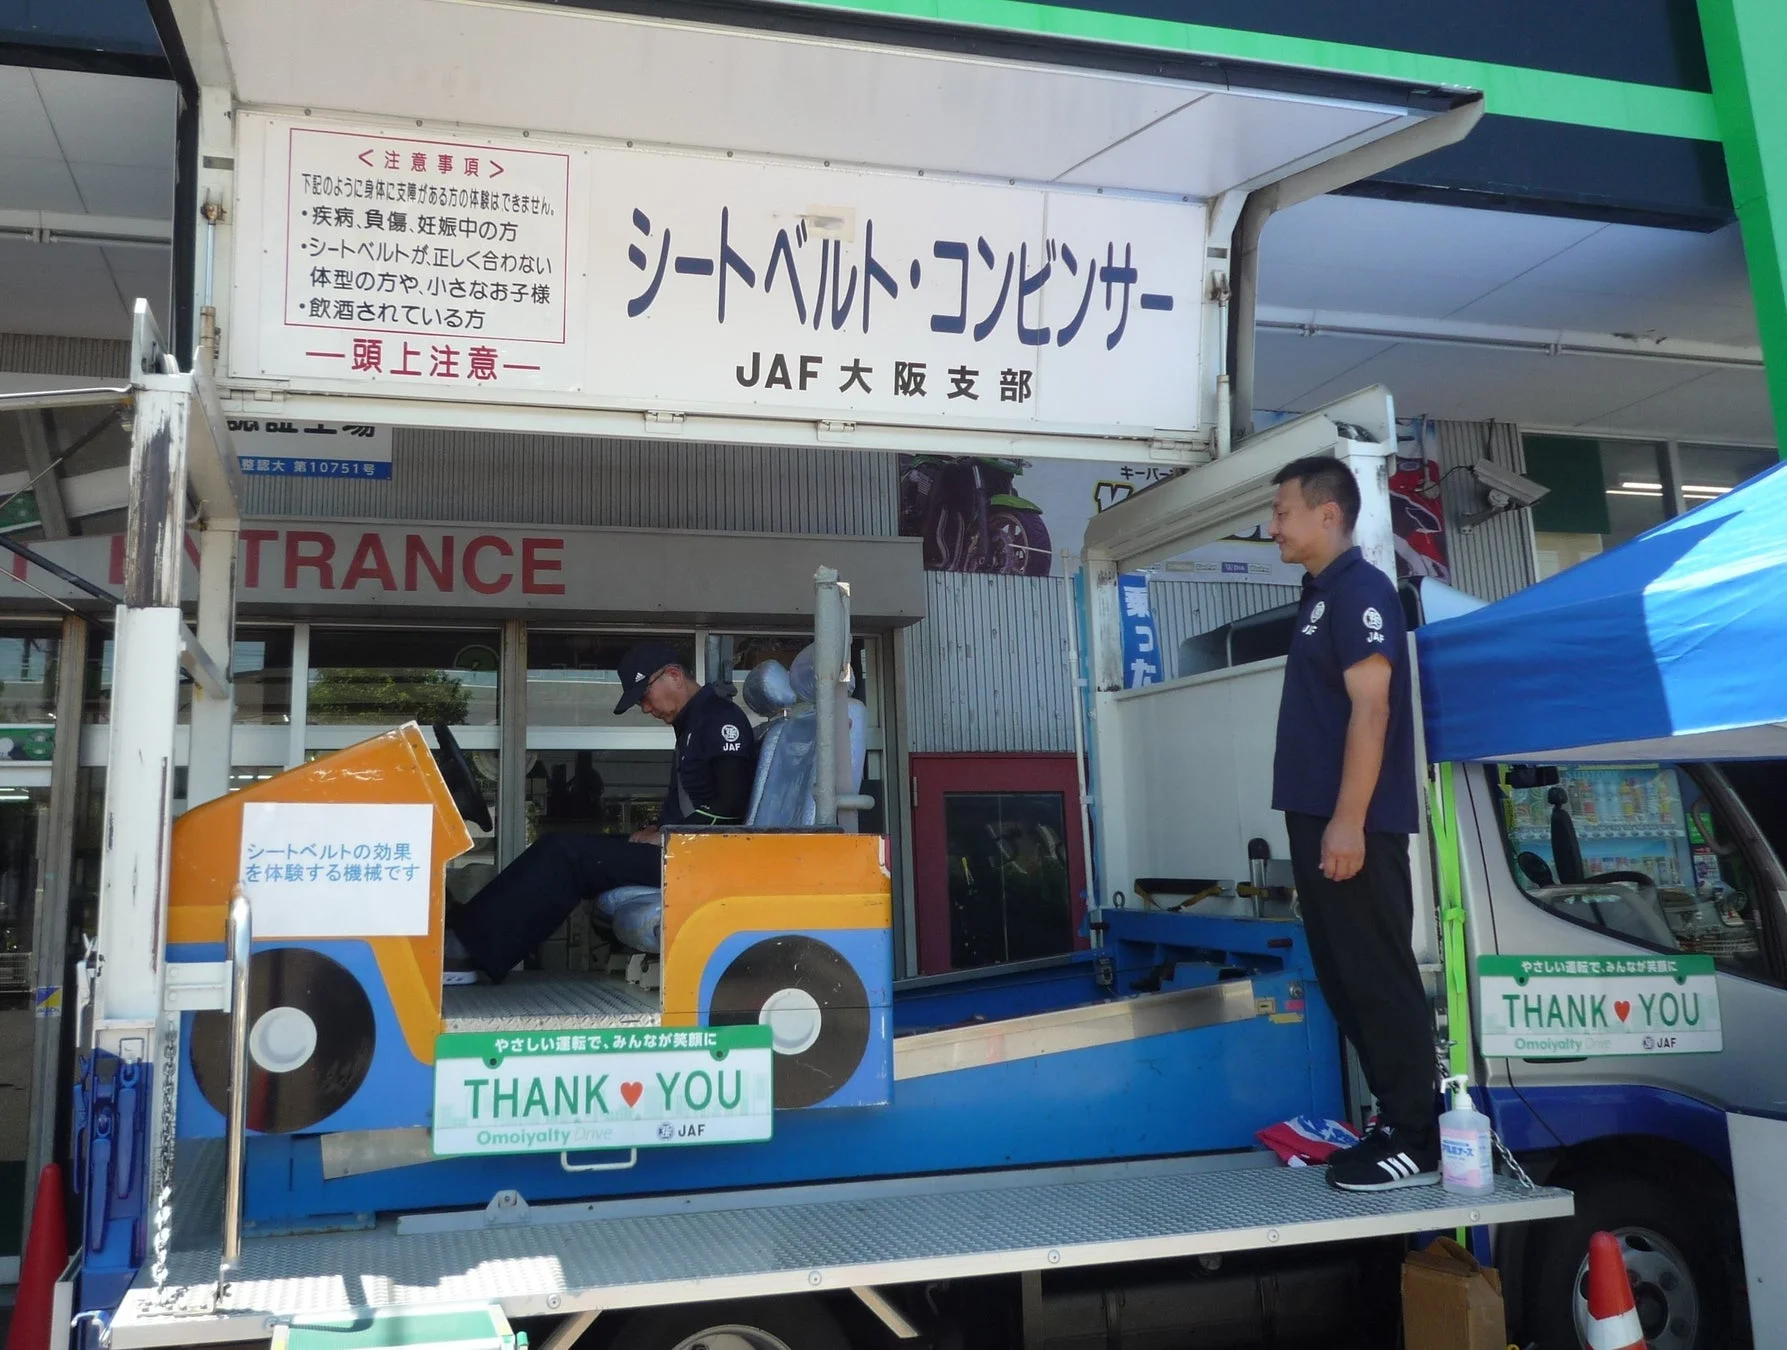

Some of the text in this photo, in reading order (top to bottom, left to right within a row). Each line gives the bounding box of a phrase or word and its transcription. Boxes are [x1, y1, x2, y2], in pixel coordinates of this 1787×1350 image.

[302, 173, 555, 217] 下記のように身体に支障がある方の体験はできません。
[310, 266, 551, 305] 体型の方や、小さなお子様
[627, 205, 1174, 351] シートベルト・コンビンサー
[294, 460, 376, 476] 第10751号
[1366, 631, 1385, 643] JAF
[723, 742, 741, 751] JAF
[247, 843, 412, 861] シートベルトの効果
[246, 863, 420, 882] を体験する機械です
[1521, 959, 1678, 974] やさしい運転で、みんなが笑顔に
[1502, 991, 1700, 1029] THANK YOU
[494, 1032, 718, 1053] やさしい運転で、みんなが笑顔に
[1514, 1037, 1583, 1053] Omoiyalty
[1656, 1037, 1677, 1049] JAF
[463, 1069, 742, 1119] THANK YOU
[476, 1127, 571, 1146] Omoiyalty
[678, 1123, 706, 1138] JAF
